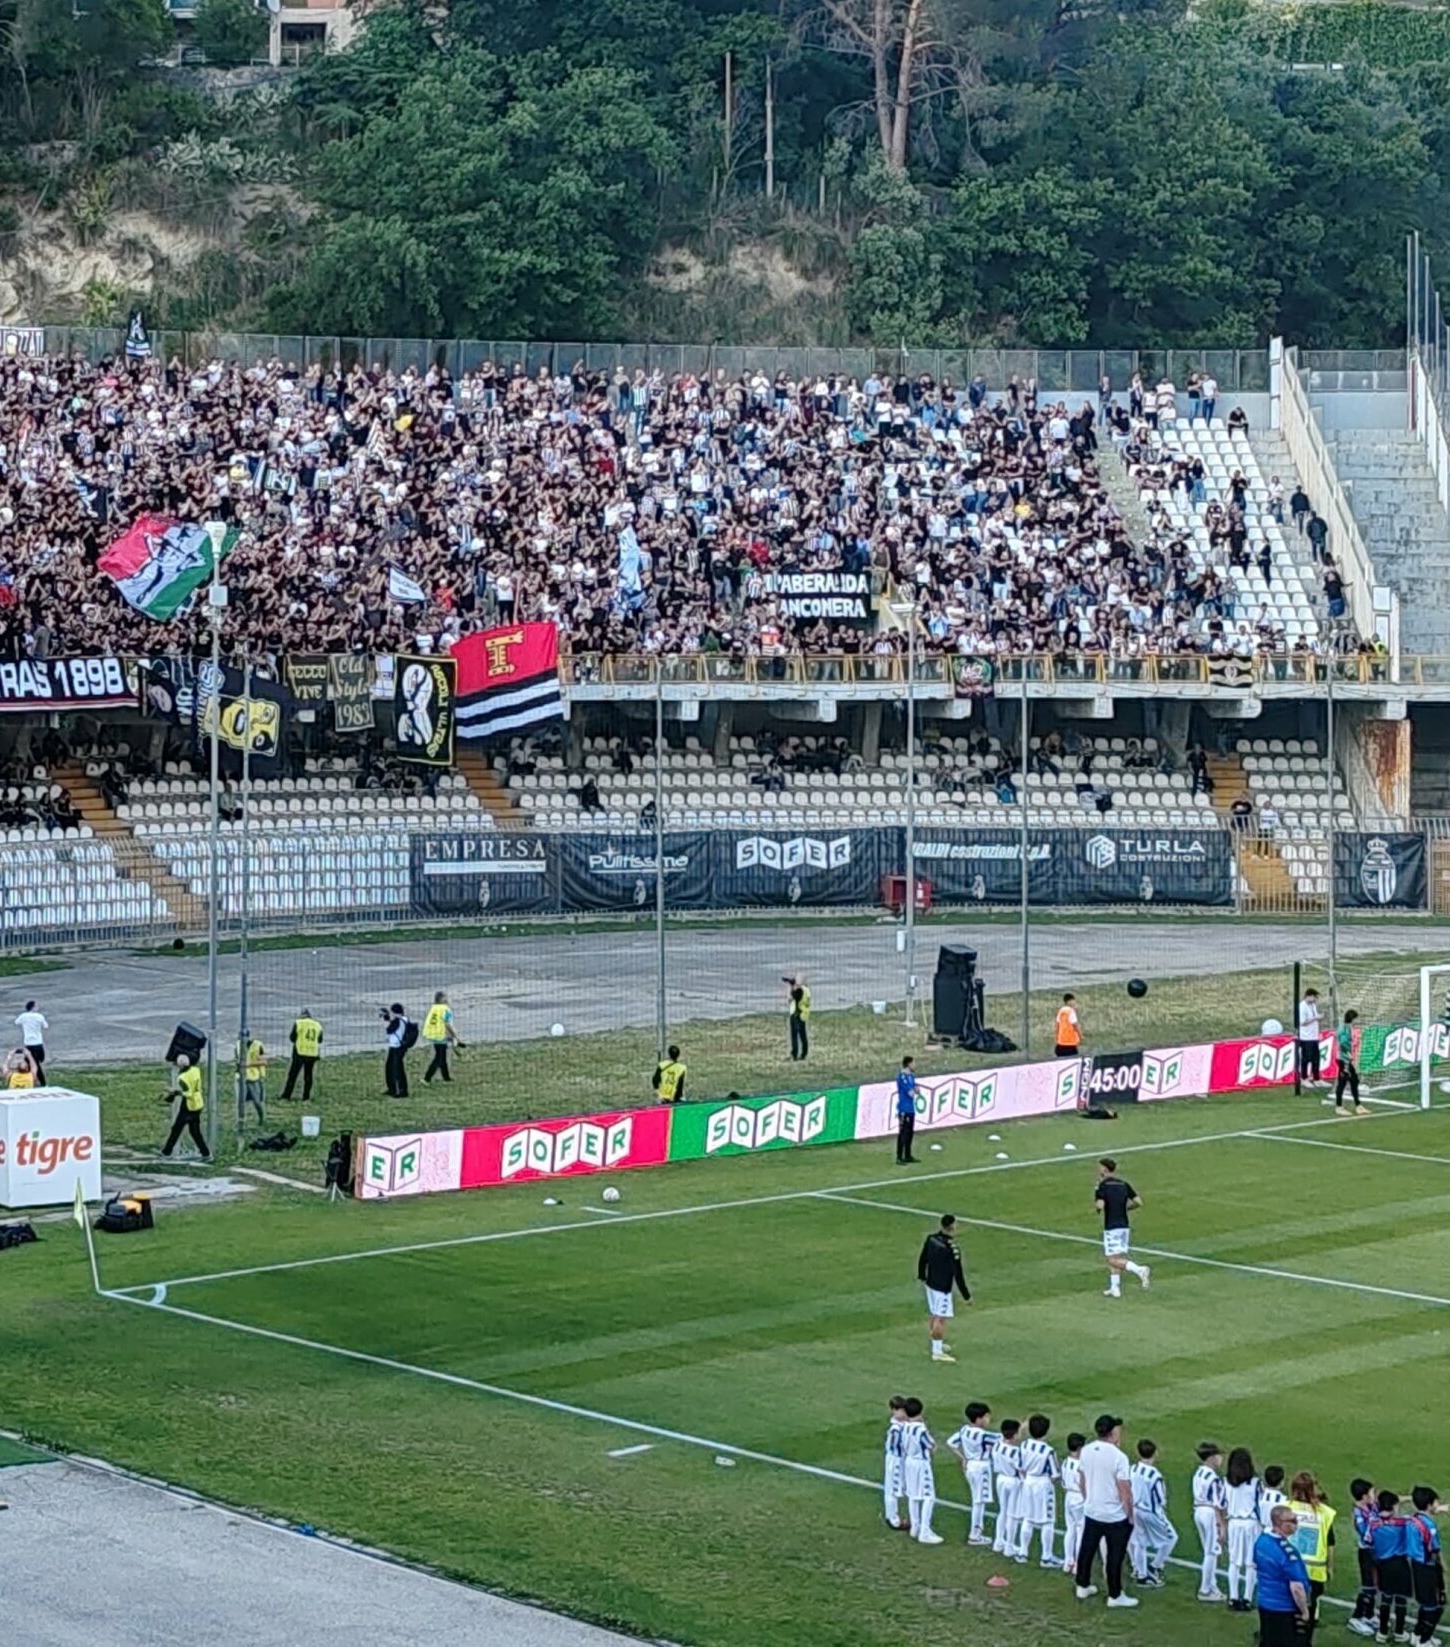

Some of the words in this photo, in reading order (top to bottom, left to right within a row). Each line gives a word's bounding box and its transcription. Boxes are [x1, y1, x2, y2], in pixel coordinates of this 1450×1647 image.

[779, 597, 867, 618] ANCONERA
[55, 657, 125, 697] 1898
[425, 839, 546, 859] EMPRESA
[740, 842, 848, 863] SOFER
[1119, 839, 1206, 853] TURLA
[1119, 853, 1206, 862] COSTRUZIONI
[1243, 1045, 1329, 1074] SOFR
[1089, 1063, 1142, 1094] 45:00
[898, 1083, 993, 1115] OFER
[711, 1104, 822, 1142] SOFER
[15, 1130, 93, 1175] tigre
[506, 1126, 627, 1167] SOFER
